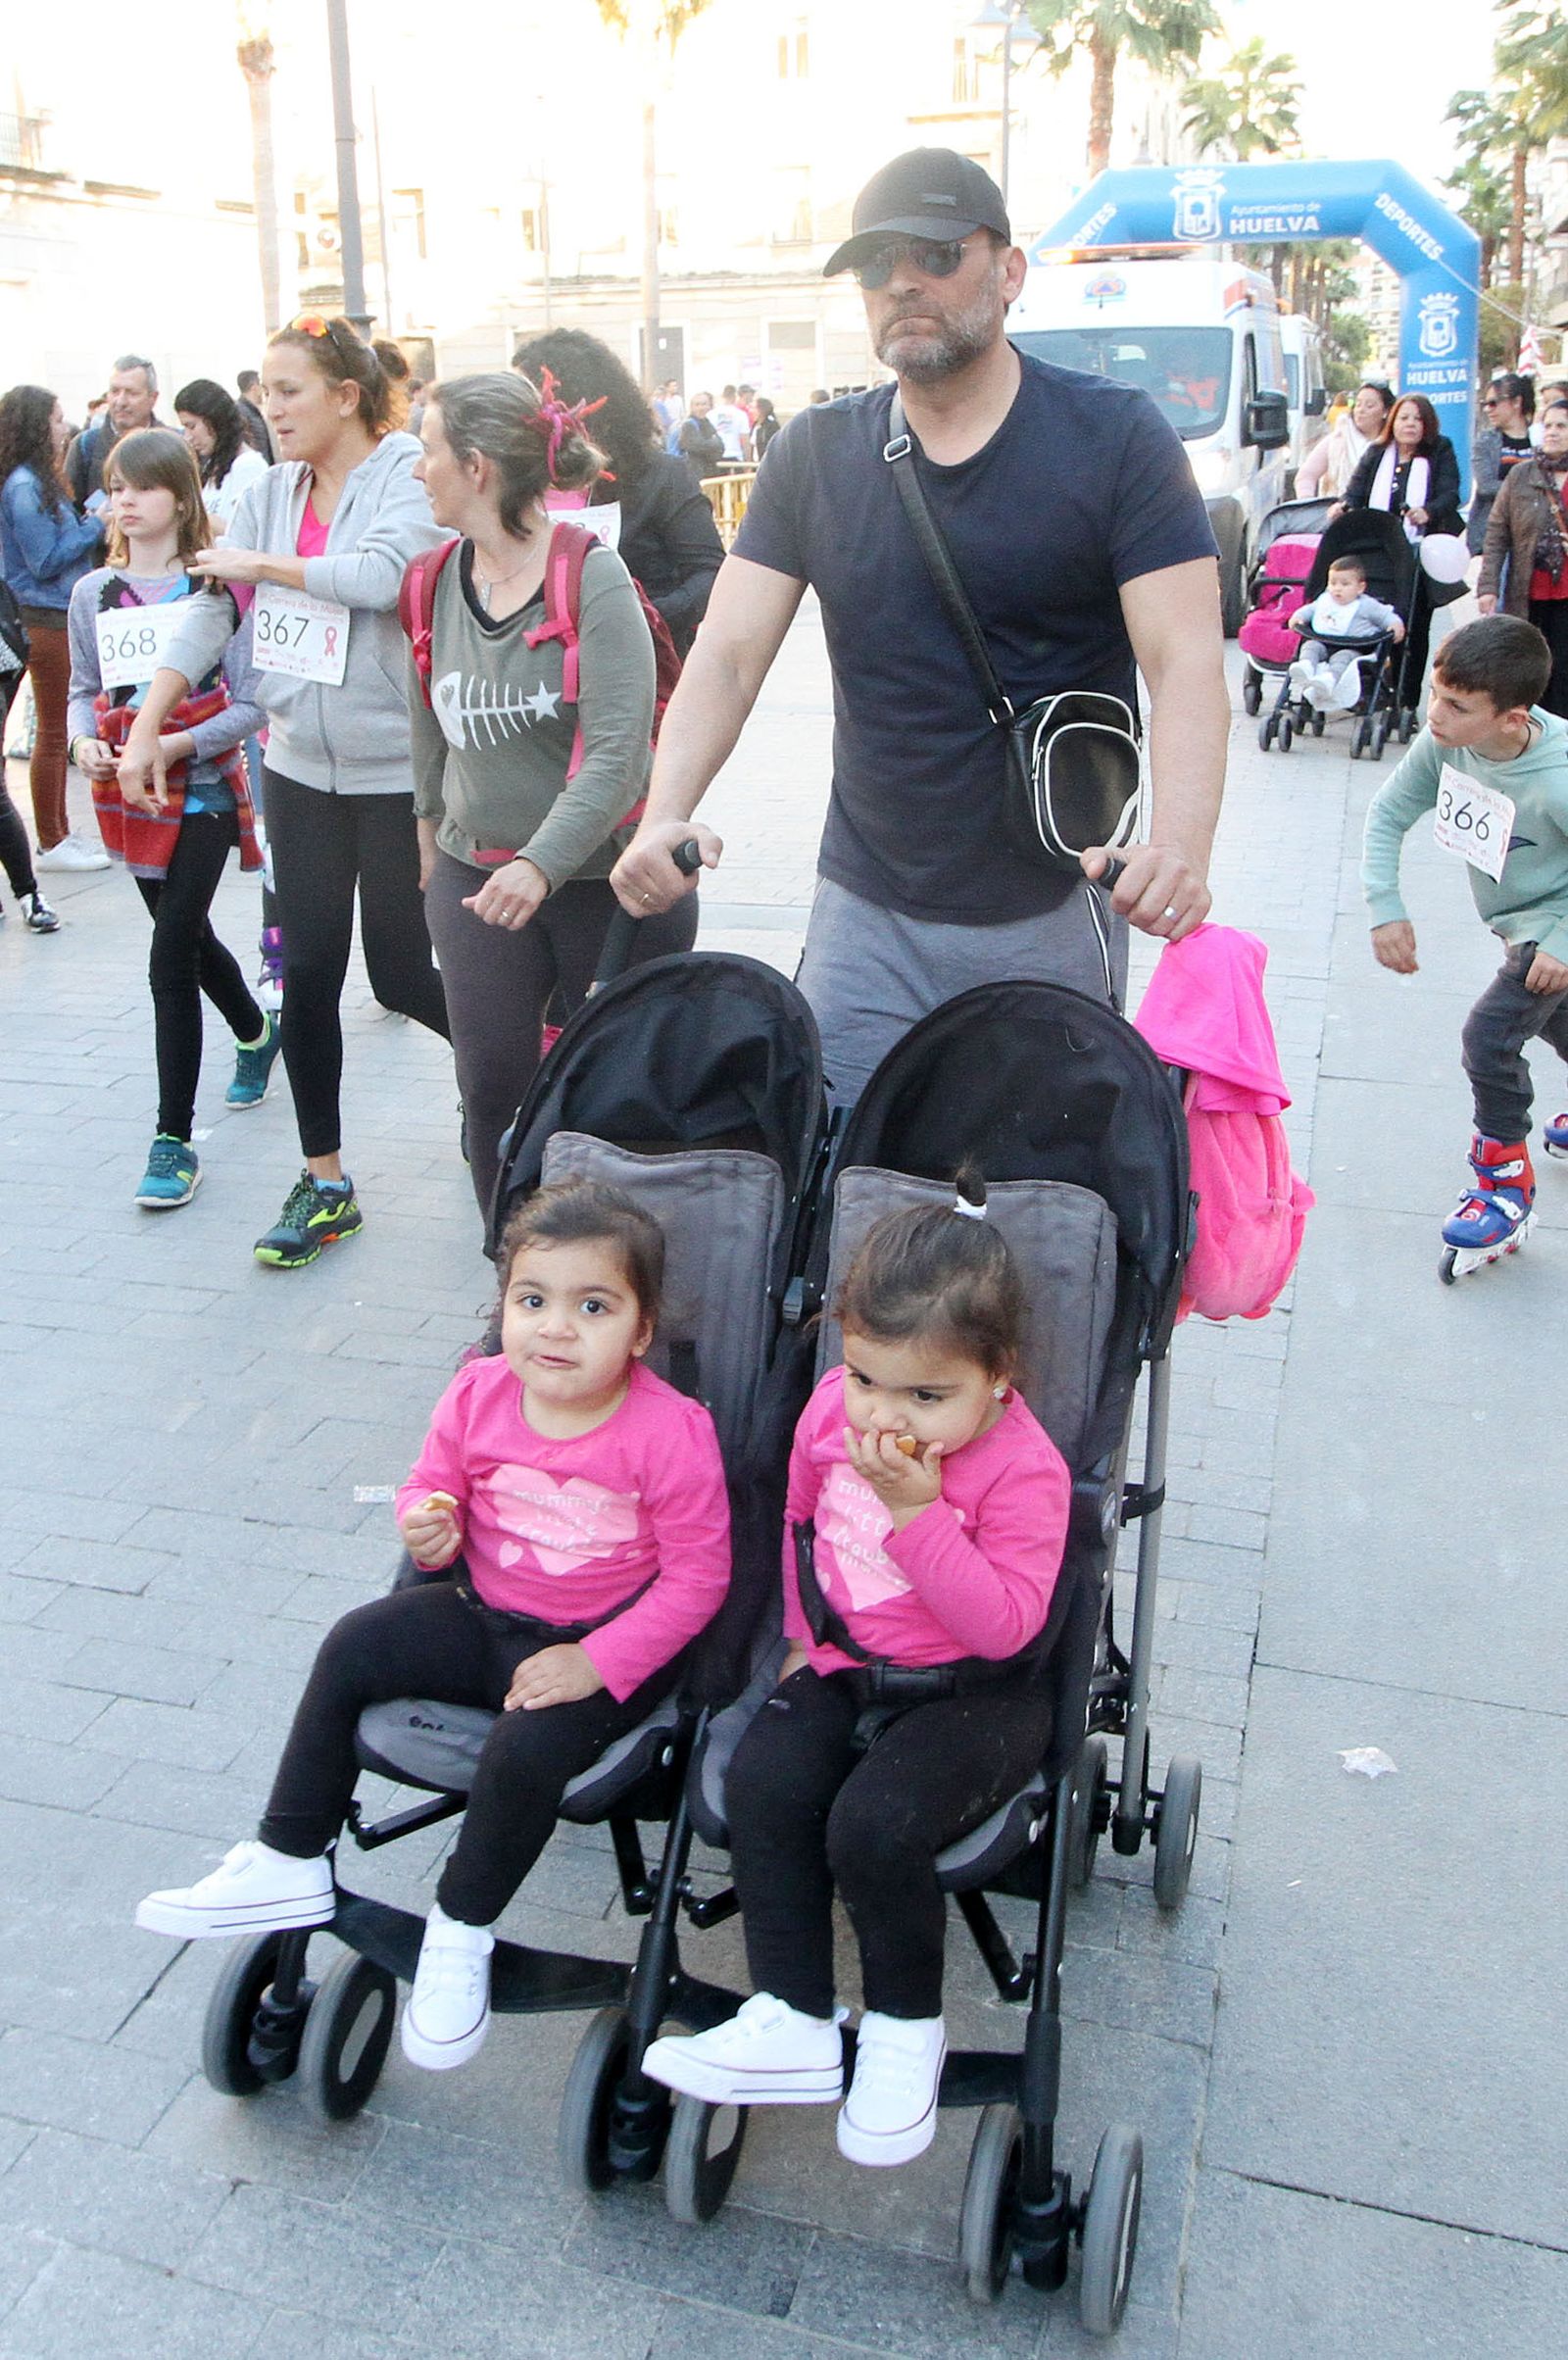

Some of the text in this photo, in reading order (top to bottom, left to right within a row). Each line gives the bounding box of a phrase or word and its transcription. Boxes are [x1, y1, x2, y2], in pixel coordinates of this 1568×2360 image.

[1070, 201, 1118, 247] ORTES
[1229, 215, 1320, 235] HUELVA
[1230, 201, 1320, 217] Ayuntamiento de
[1374, 192, 1445, 261] DEPORTES
[1406, 368, 1468, 386] HUELVA
[1428, 390, 1468, 405] ORTES
[101, 627, 157, 663] 368
[257, 609, 311, 648] 367
[1439, 789, 1491, 841] 366
